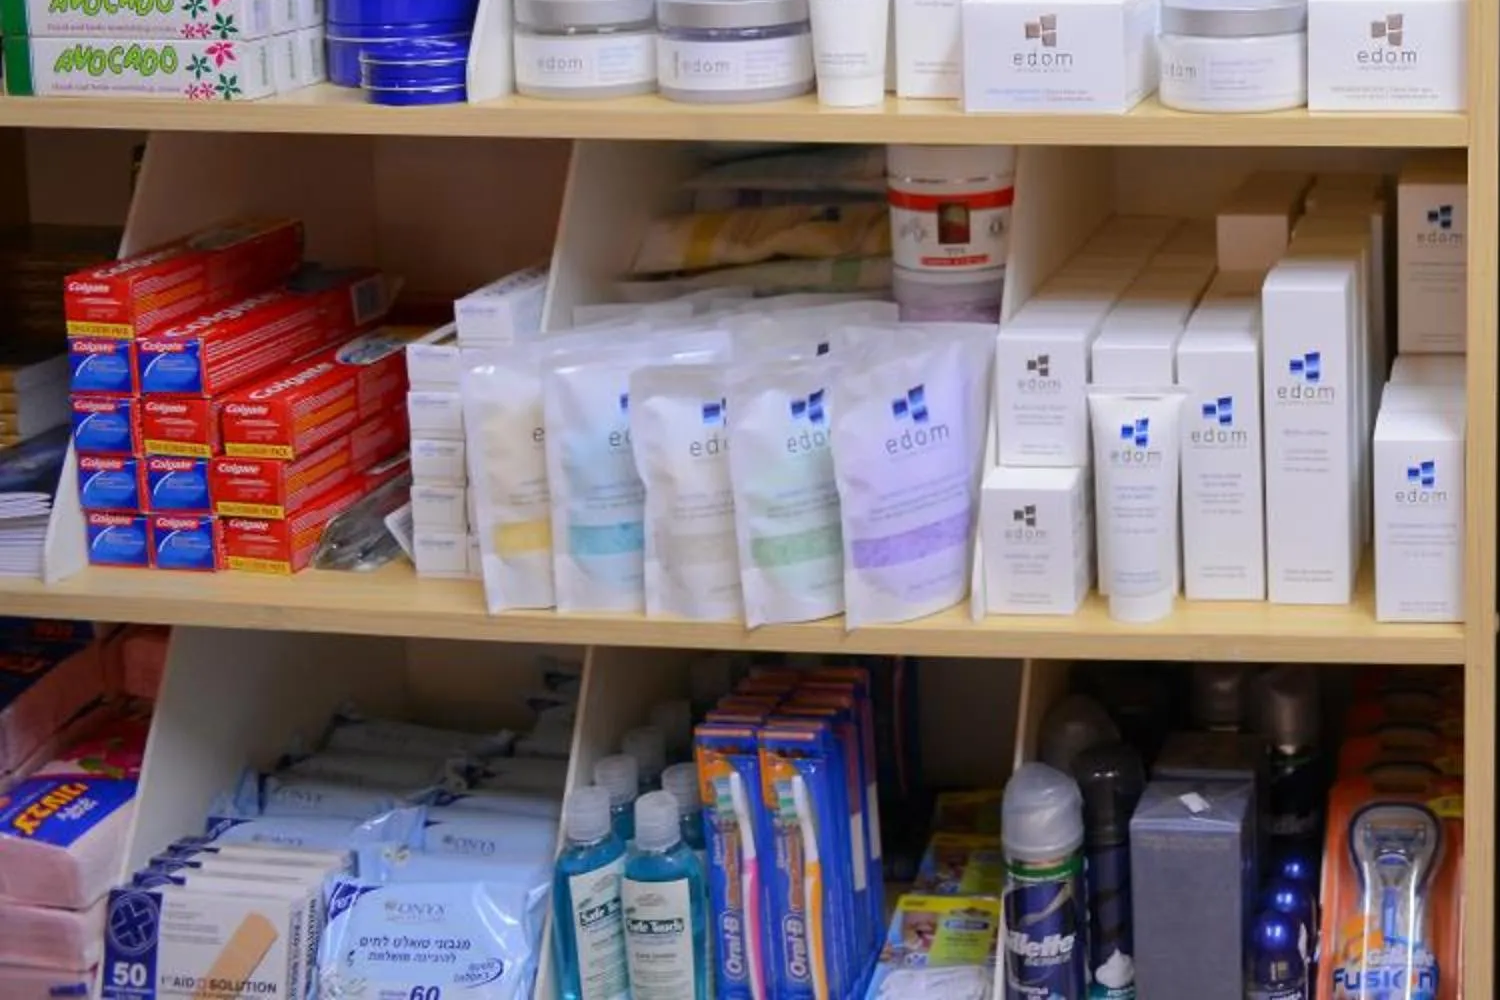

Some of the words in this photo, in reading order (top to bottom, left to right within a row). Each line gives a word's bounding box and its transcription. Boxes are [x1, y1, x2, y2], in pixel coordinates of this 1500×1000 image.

[54, 44, 178, 76] AVOCADO
[536, 55, 583, 71] edom
[1013, 50, 1073, 68] edom
[1357, 47, 1417, 65] edom
[1417, 231, 1463, 245] edom
[68, 281, 110, 295] Colgate
[72, 340, 115, 353] Colgate
[141, 340, 183, 353] Colgate
[1018, 377, 1061, 391] edom
[1277, 383, 1334, 400] edom
[73, 399, 115, 412] Colgate
[145, 402, 187, 414] Colgate
[225, 404, 269, 416] Colgate
[885, 422, 949, 455] edom
[1192, 426, 1247, 443] edom
[690, 436, 728, 458] ed
[1110, 447, 1161, 463] edom
[80, 457, 121, 470] Colgate
[151, 459, 192, 470] Colgate
[218, 463, 260, 475] Colgate
[1395, 487, 1447, 503] edom
[89, 513, 131, 525] Colgate
[157, 517, 198, 529] Colgate
[229, 519, 269, 531] Colgate
[723, 916, 742, 974] Oral-B
[786, 917, 807, 977] Oral-B
[112, 961, 148, 987] 50
[208, 977, 278, 994] SOLUTION
[410, 985, 440, 1000] 60
